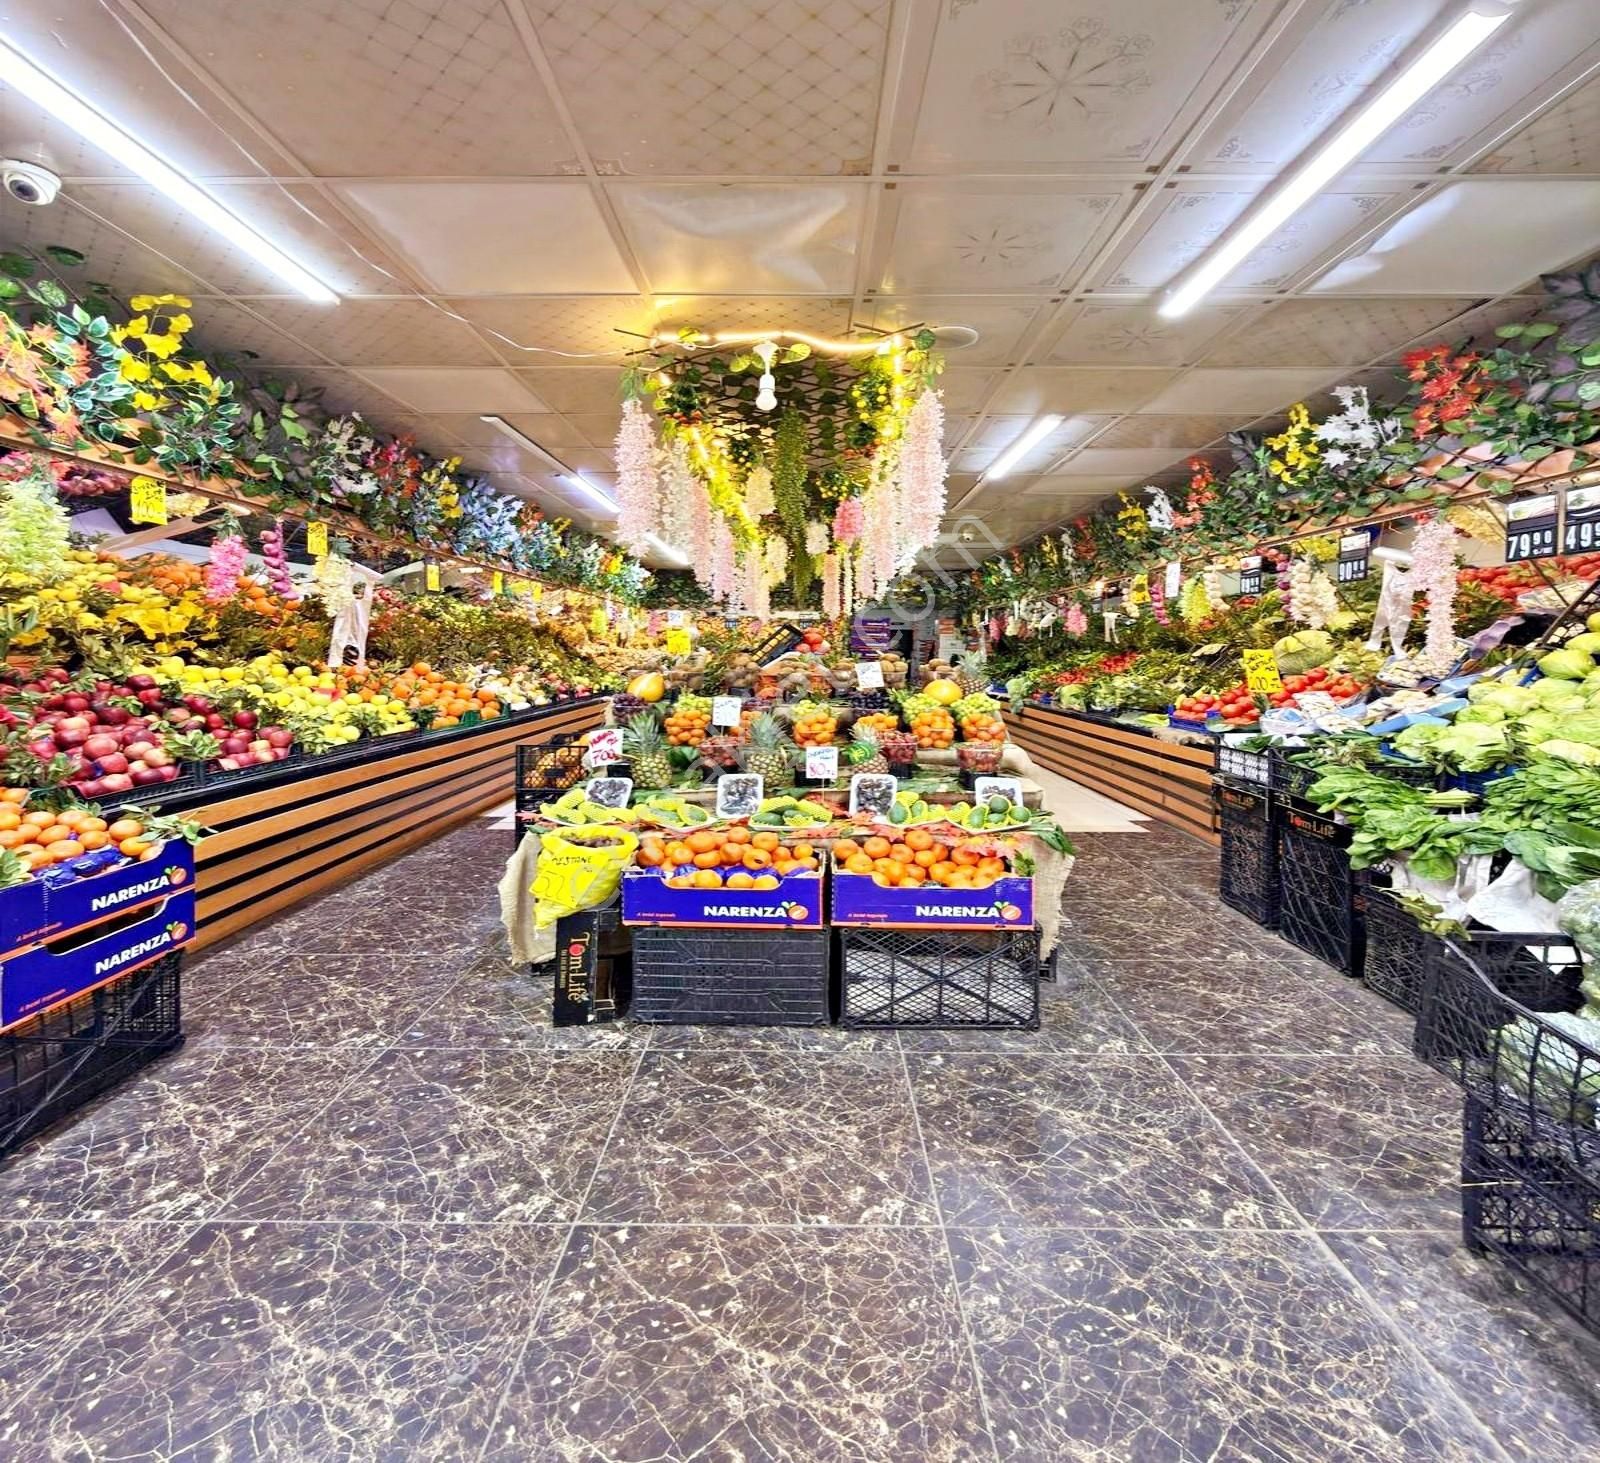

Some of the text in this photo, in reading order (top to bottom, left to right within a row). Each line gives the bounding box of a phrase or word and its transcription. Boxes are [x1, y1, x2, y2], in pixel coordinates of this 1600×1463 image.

[91, 875, 170, 911] NARENZA
[703, 905, 787, 918] NARENZA
[915, 905, 1000, 918] NARENZA
[95, 931, 171, 974] NARENZA
